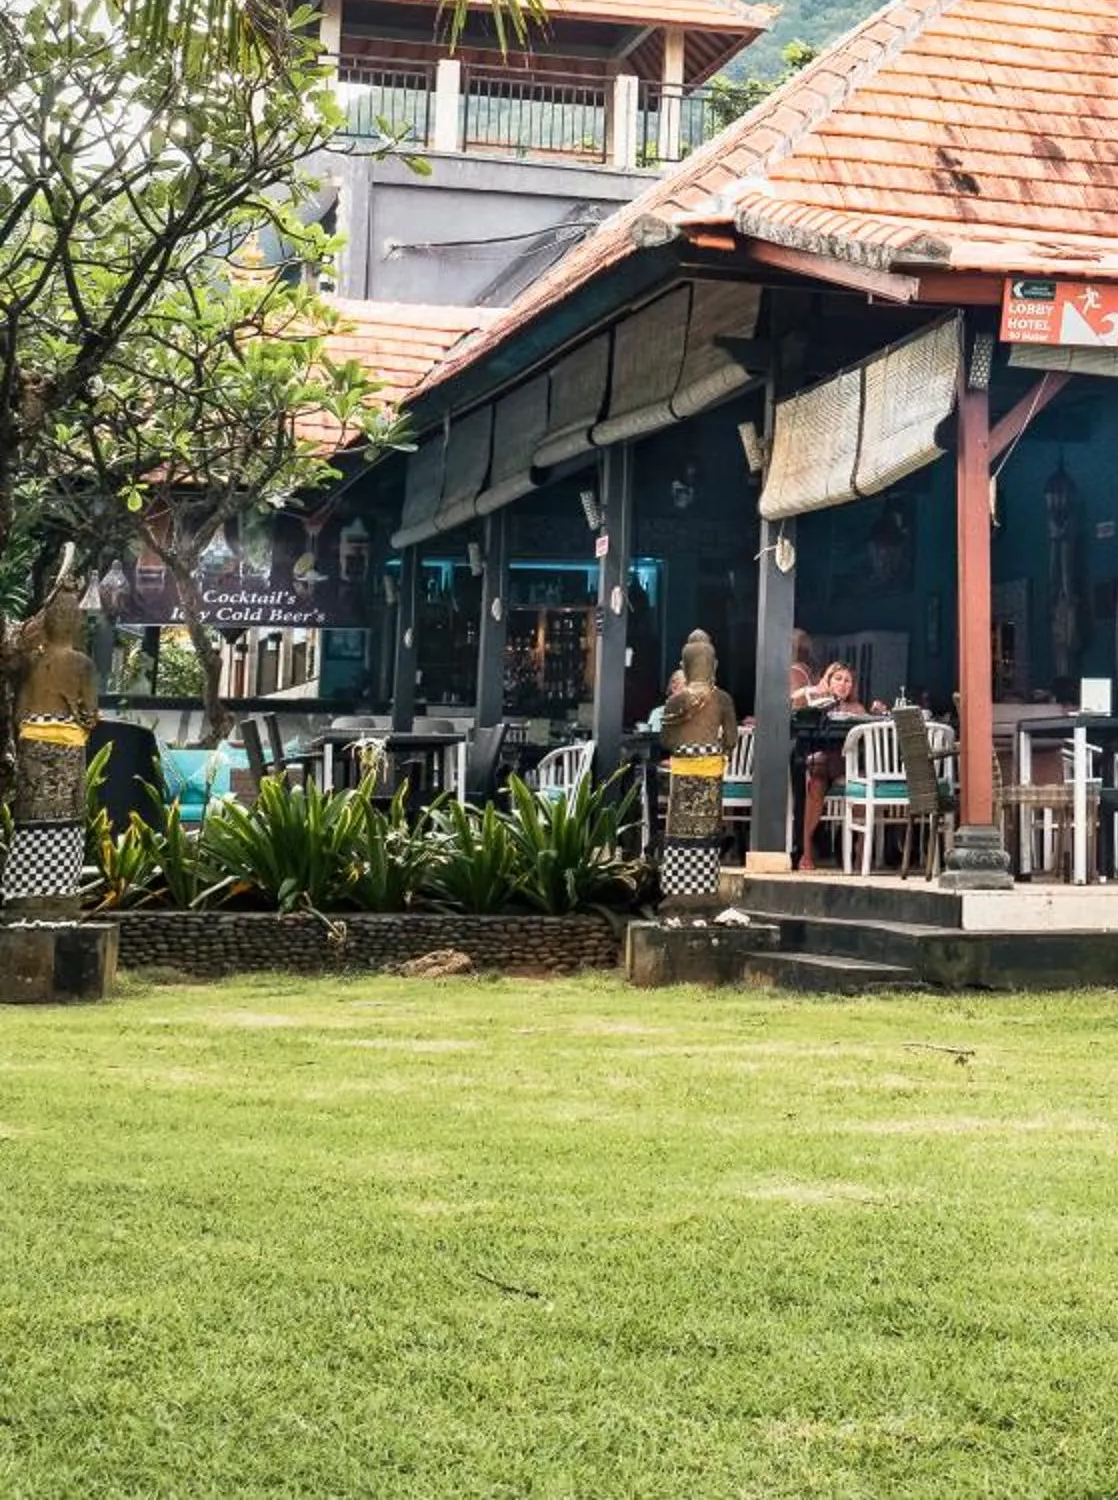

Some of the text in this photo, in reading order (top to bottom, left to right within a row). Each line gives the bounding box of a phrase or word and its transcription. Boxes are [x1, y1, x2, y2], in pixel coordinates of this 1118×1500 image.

[1008, 302, 1055, 316] LOBBY
[1007, 318, 1052, 331] HOTEL
[203, 589, 297, 605] Cocktail's
[216, 606, 263, 622] Cold
[269, 608, 326, 622] Beer's
